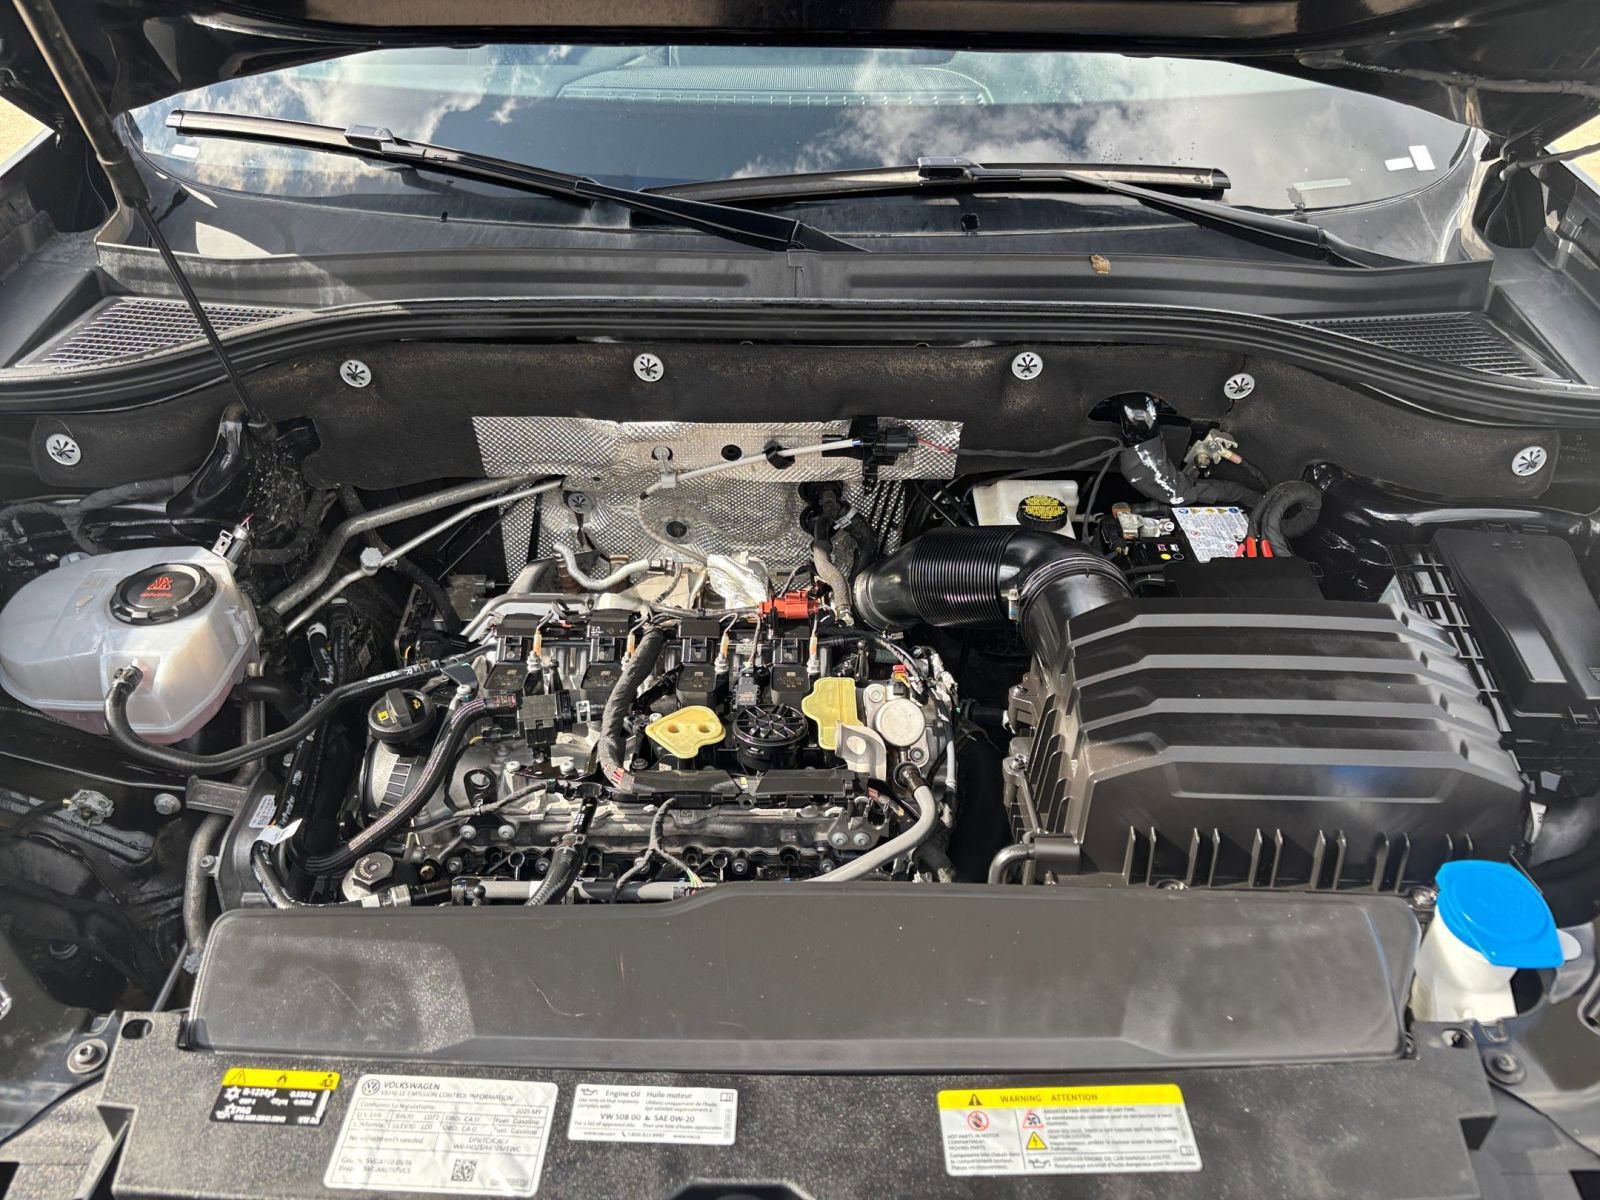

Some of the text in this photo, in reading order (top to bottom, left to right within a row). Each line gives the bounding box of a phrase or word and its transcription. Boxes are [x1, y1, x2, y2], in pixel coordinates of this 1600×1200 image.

[382, 1080, 441, 1090] VOLKSWAGEN
[999, 1094, 1042, 1103] WARNING
[1050, 1093, 1098, 1101] ATTENTION
